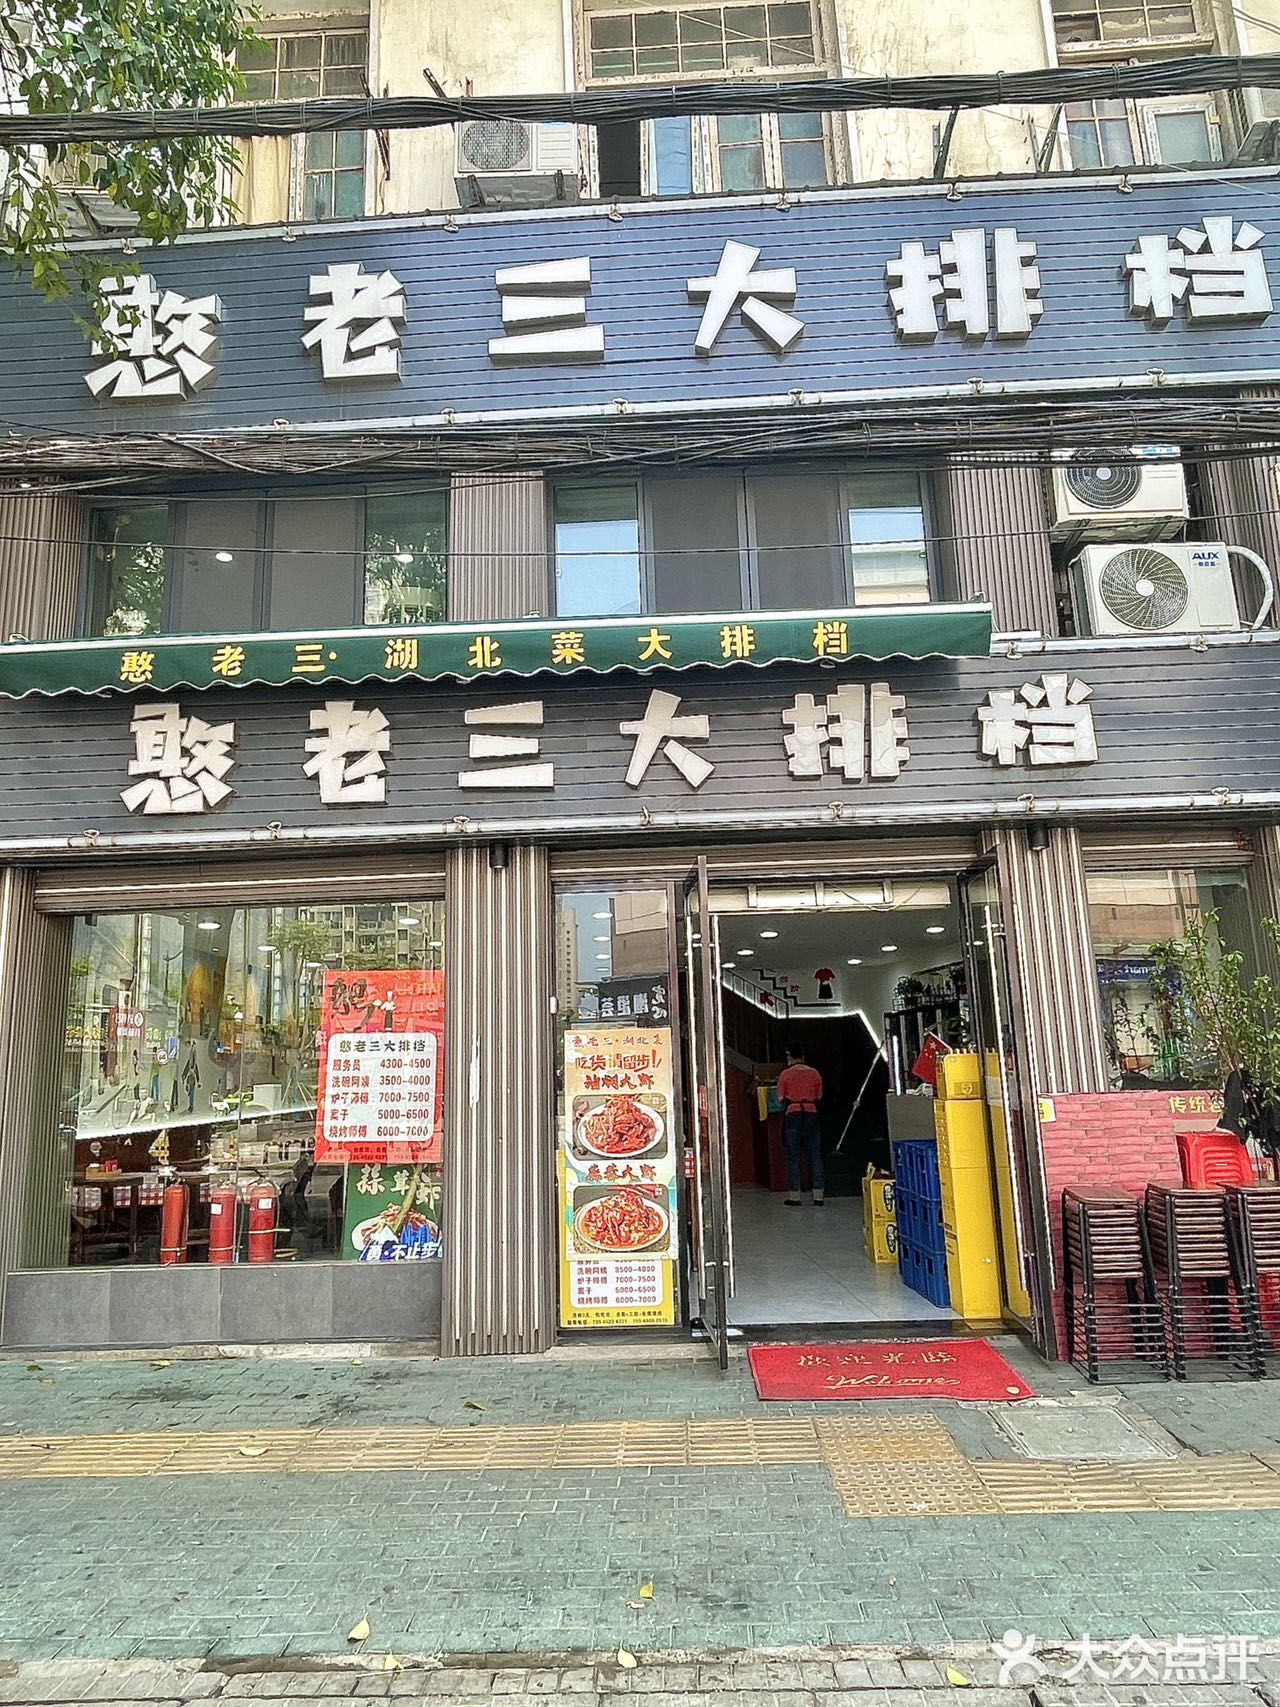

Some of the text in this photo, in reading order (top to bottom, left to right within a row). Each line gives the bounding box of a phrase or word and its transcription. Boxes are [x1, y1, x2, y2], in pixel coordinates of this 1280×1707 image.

[83, 215, 1274, 400] 憨老三大排档
[1192, 551, 1219, 560] AUX
[119, 673, 1100, 815] 憨老三大排档
[332, 1058, 431, 1072] 服务员 4300-4500
[331, 1075, 431, 1088] 洗碗阿姨 3500-4000
[379, 1091, 430, 1103] 7000-7500
[377, 1109, 429, 1120] 5000-6500
[328, 1125, 429, 1138] 烧烤师傅 6000-7000
